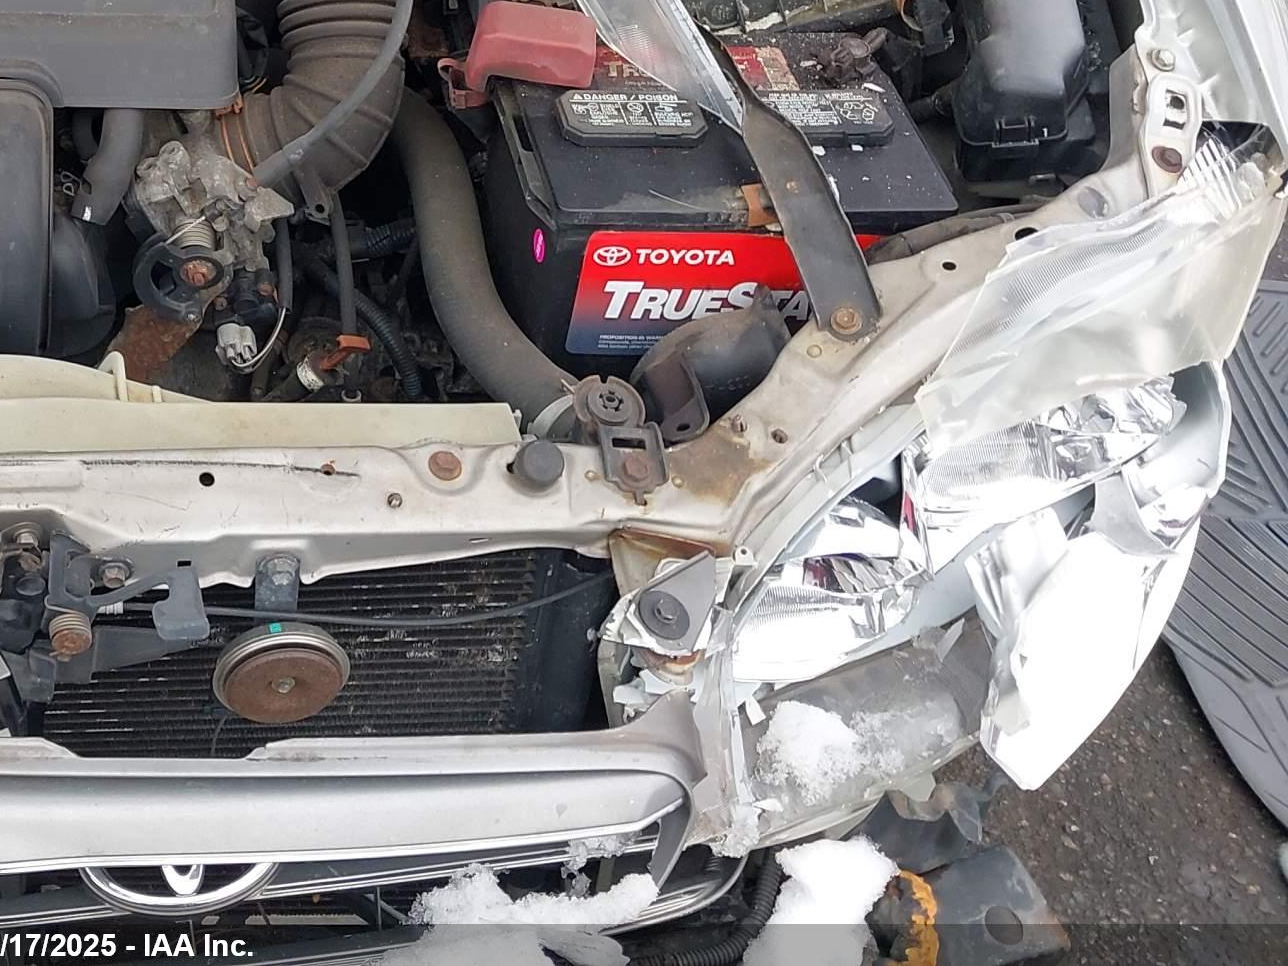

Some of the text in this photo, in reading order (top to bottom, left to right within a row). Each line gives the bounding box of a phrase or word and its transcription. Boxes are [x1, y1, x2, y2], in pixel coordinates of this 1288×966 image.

[584, 93, 628, 101] DANGER
[638, 93, 678, 101] POISON
[636, 248, 735, 266] TOYOTA
